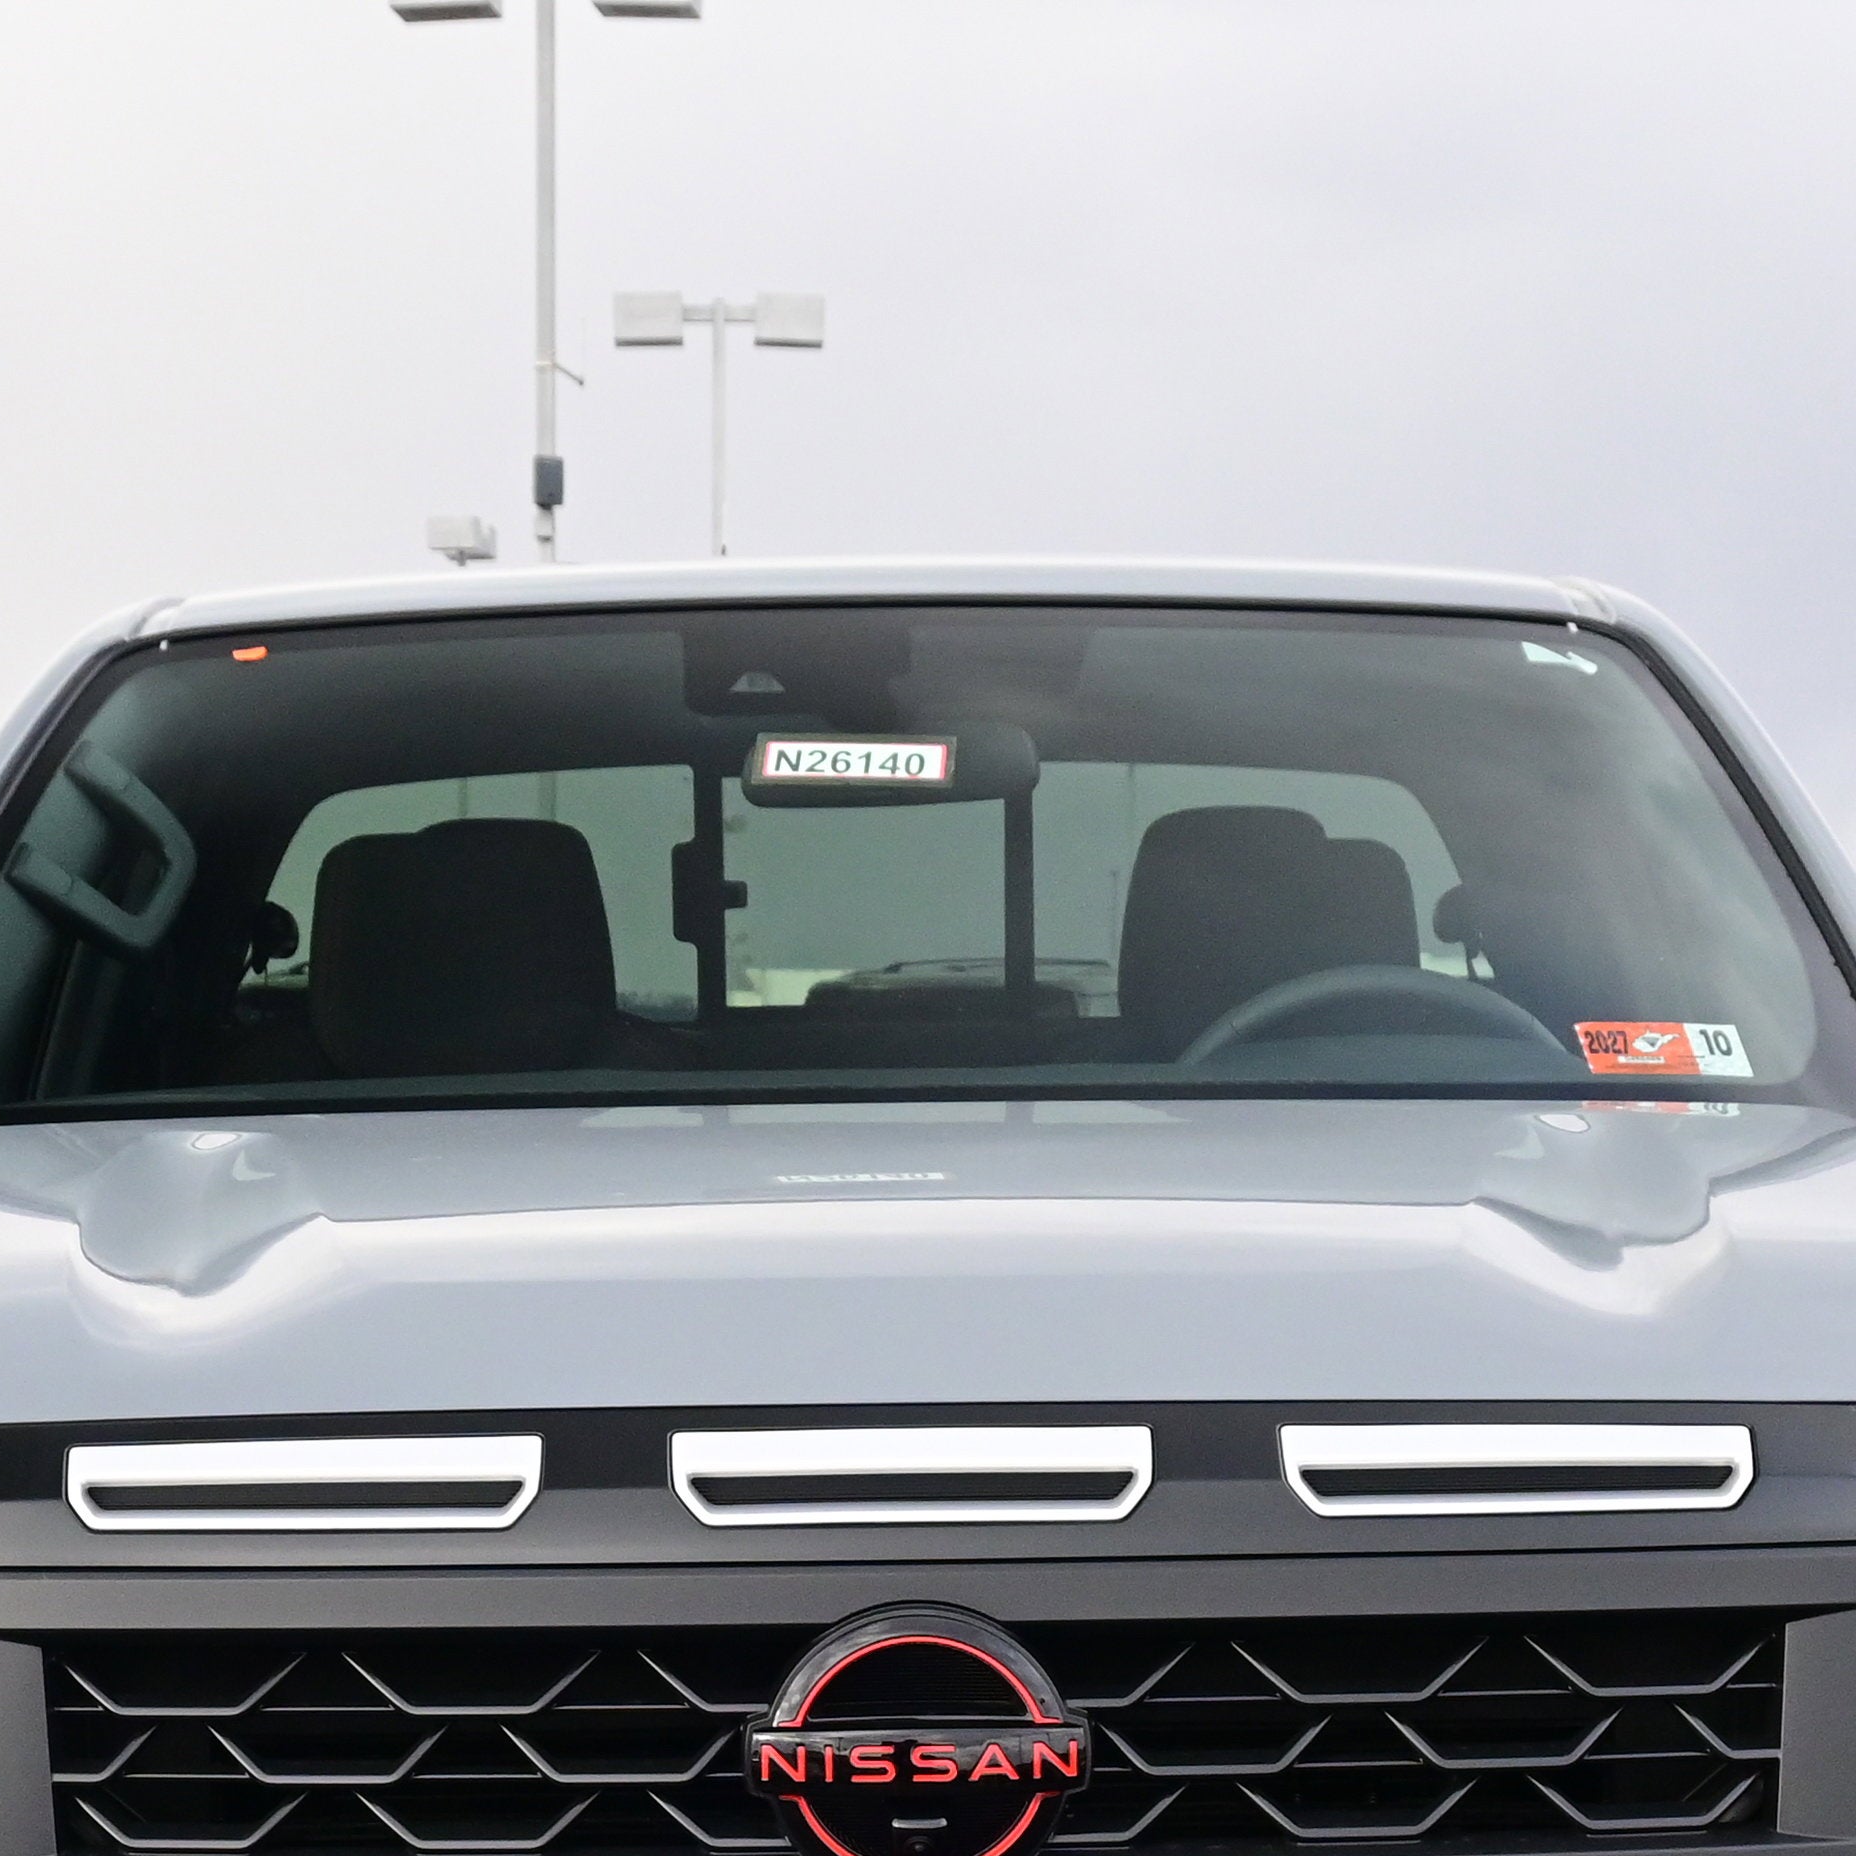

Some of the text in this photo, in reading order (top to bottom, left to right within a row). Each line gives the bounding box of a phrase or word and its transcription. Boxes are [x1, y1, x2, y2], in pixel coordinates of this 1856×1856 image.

[774, 749, 926, 776] N26140
[1584, 1030, 1629, 1054] 2027
[1699, 1029, 1733, 1057] 10
[759, 1739, 1079, 1783] NISSAN
